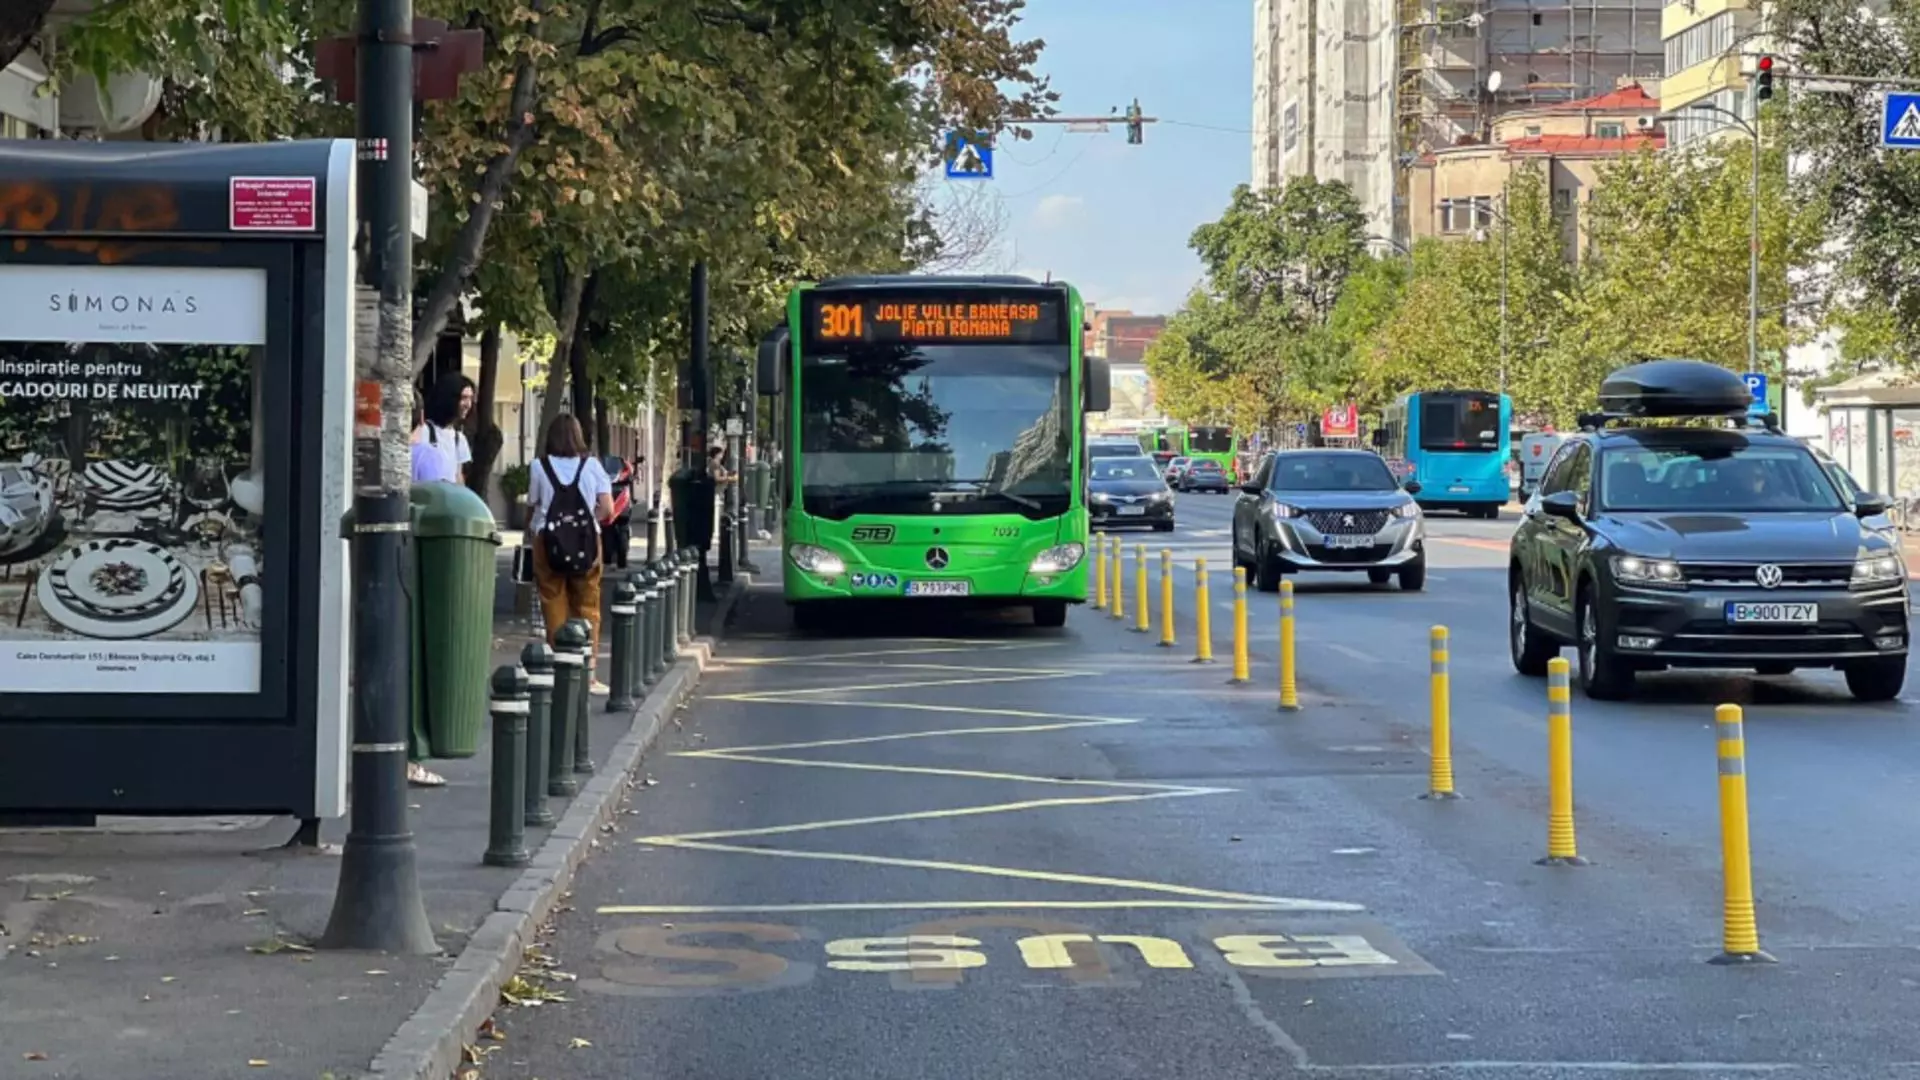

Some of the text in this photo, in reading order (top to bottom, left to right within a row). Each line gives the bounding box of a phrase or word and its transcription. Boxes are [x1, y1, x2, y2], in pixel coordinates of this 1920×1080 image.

[820, 304, 863, 337] 301
[876, 304, 1039, 321] JOLIE VILLE BANEASA
[902, 320, 1010, 337] PIATA ROMANA
[84, 361, 142, 379] pentru
[0, 382, 203, 401] CADOURI DE NEUITAT
[1747, 377, 1760, 392] P
[852, 527, 893, 541] STB
[824, 933, 1400, 973] BUS
